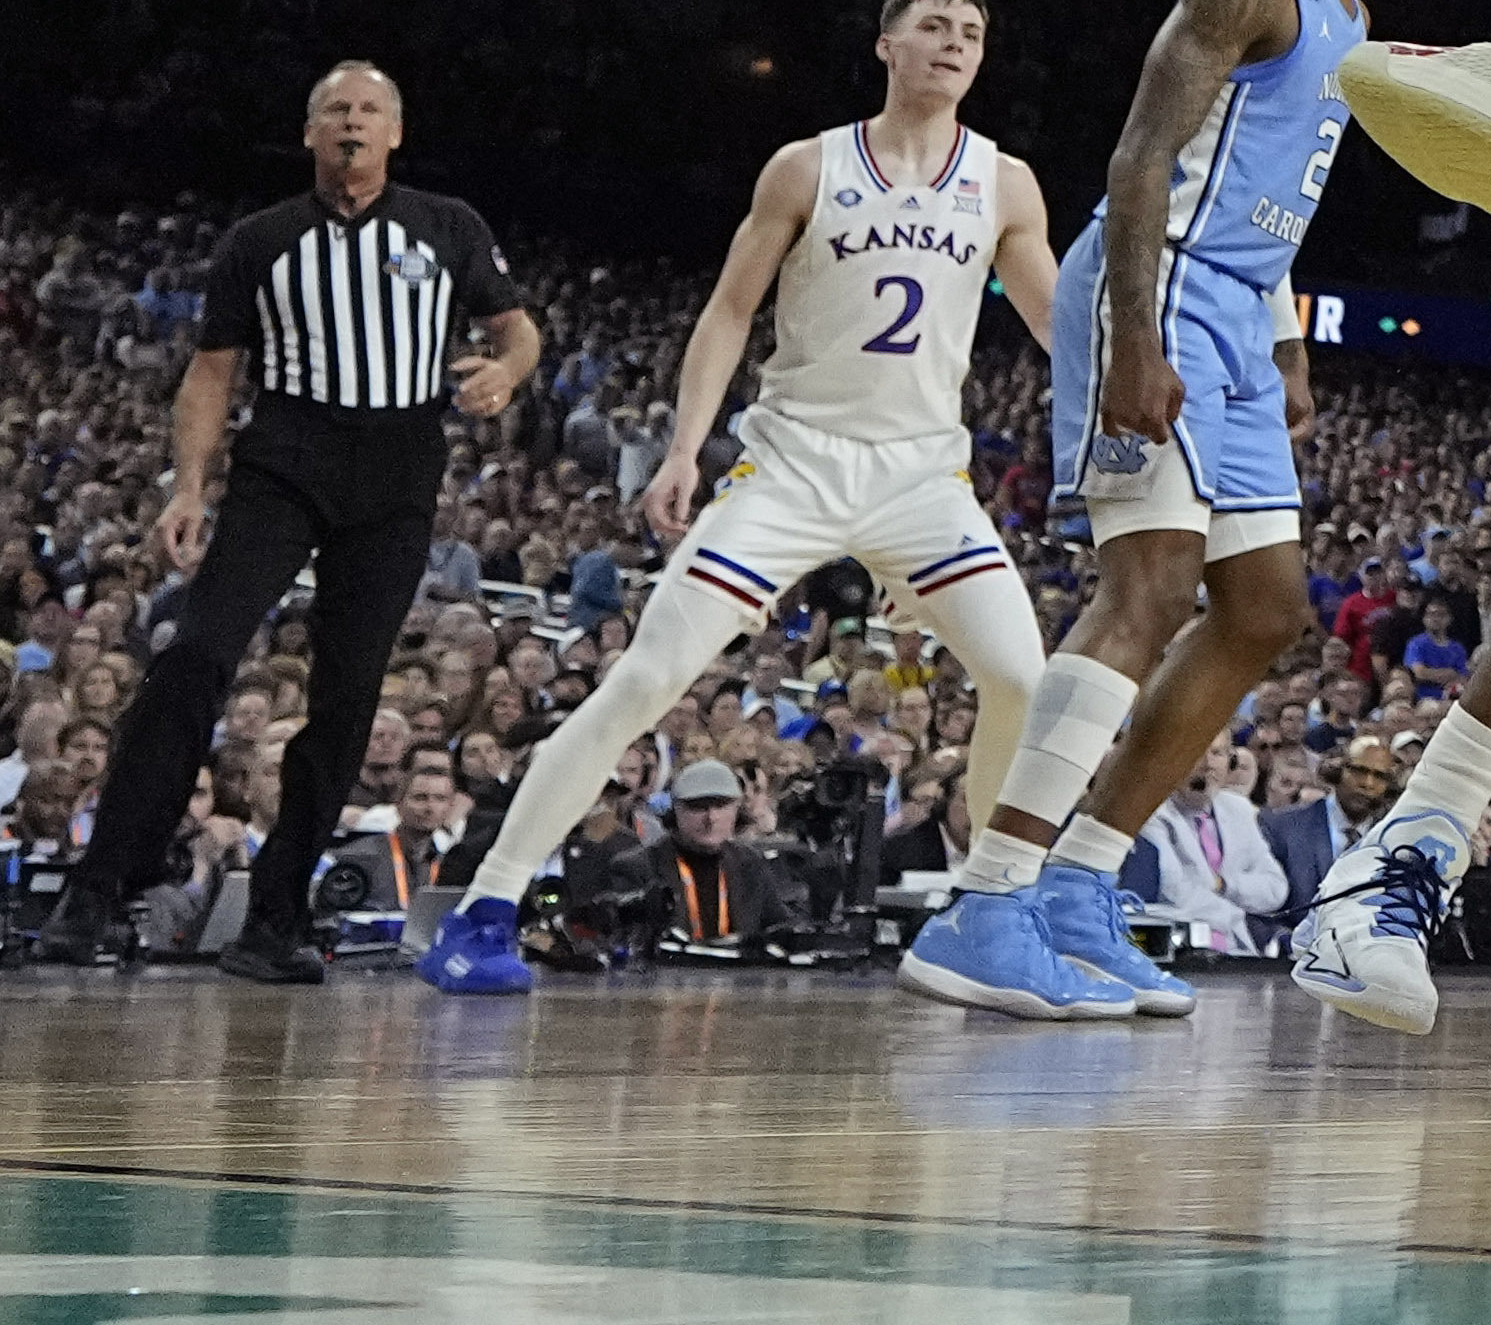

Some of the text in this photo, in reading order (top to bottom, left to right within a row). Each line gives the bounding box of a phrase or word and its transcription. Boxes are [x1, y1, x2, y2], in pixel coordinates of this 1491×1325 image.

[829, 223, 976, 265] KANSAS
[1252, 197, 1307, 246] CARO
[862, 276, 923, 353] 2
